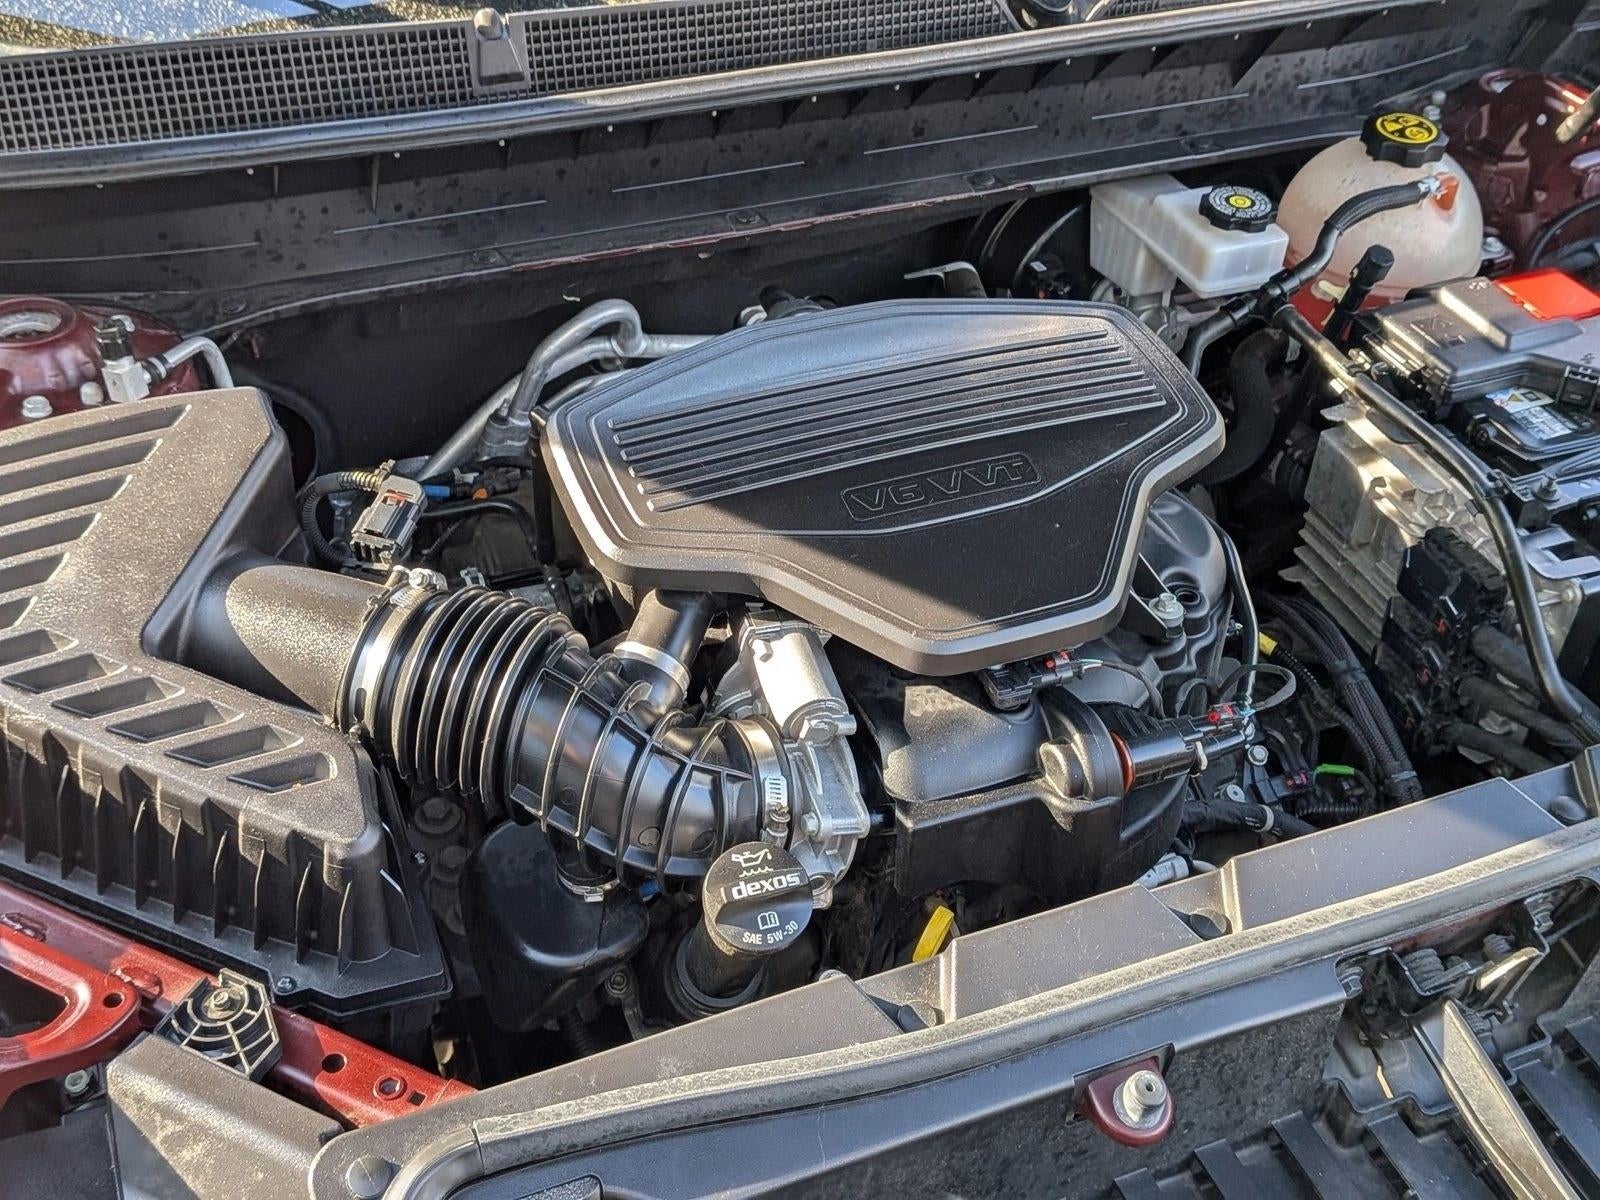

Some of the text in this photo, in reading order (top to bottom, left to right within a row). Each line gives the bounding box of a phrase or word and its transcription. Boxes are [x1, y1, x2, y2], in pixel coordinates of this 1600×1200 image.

[850, 460, 1024, 511] V6 VVT
[731, 872, 801, 900] dexos
[742, 921, 798, 945] SAE 5W-30
